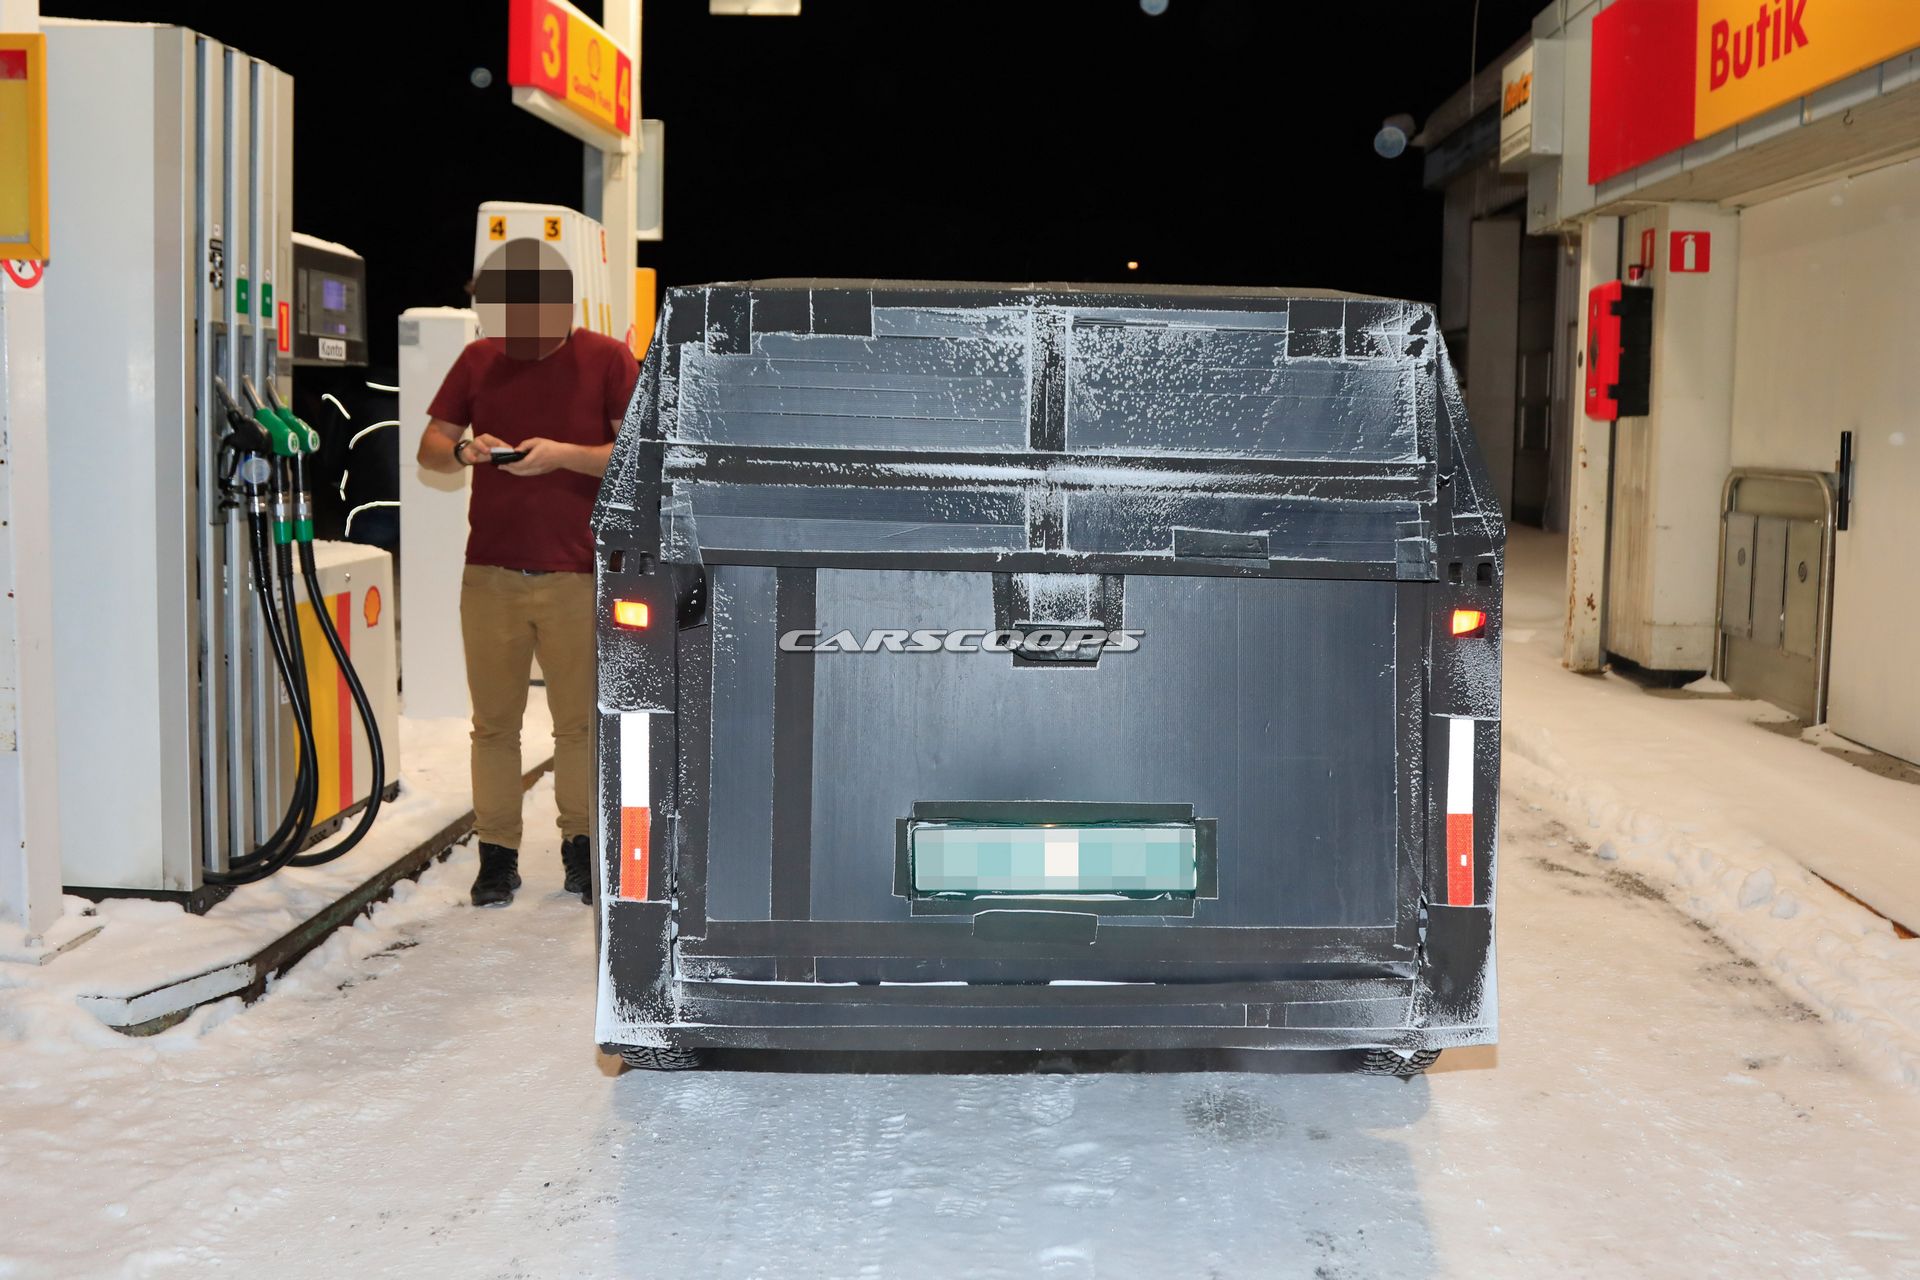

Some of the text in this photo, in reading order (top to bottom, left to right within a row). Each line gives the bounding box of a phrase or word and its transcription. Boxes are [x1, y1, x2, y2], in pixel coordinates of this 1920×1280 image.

[543, 13, 561, 79] 3
[1710, 0, 1809, 93] Butik
[618, 67, 629, 121] 4
[491, 219, 505, 237] 4
[546, 219, 559, 238] 3
[320, 341, 344, 358] Konto
